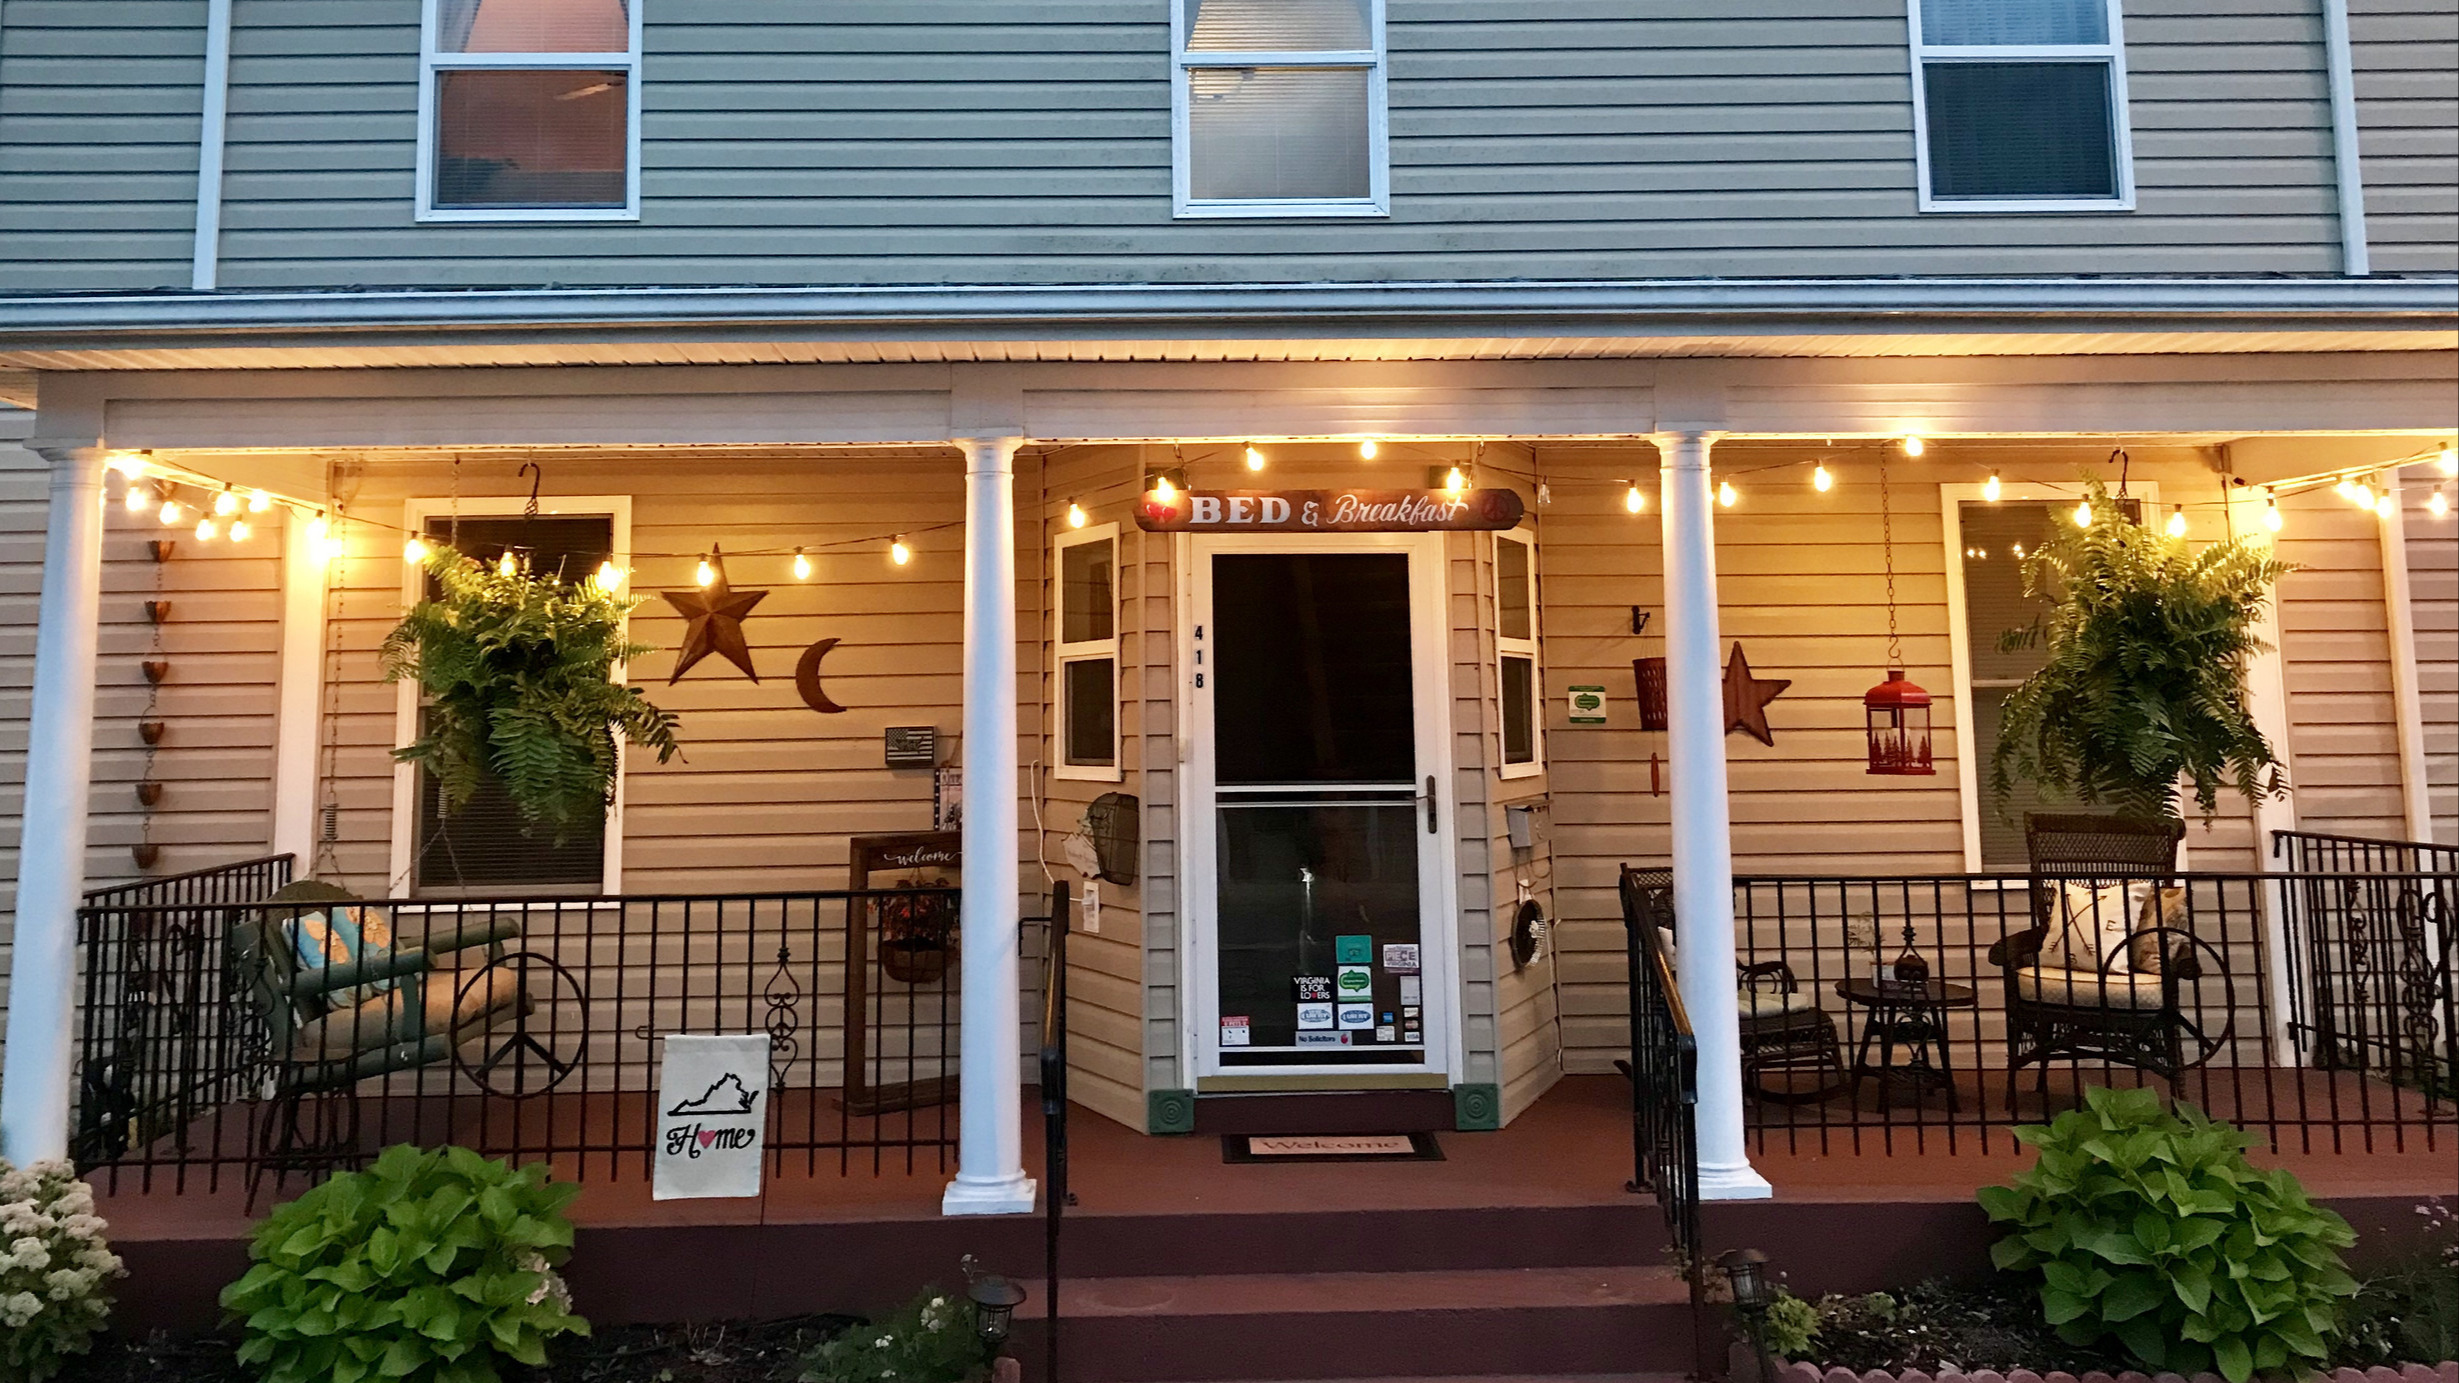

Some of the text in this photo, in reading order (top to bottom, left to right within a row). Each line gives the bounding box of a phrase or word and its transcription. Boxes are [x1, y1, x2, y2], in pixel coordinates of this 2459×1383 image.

[1189, 494, 1469, 526] BED & Breakfast
[1194, 625, 1204, 689] 418
[883, 846, 962, 866] welcome
[2105, 919, 2116, 932] E
[1293, 976, 1331, 984] VIRGINIA
[1300, 984, 1326, 992] IS FOR
[1300, 991, 1331, 999] LOERS
[666, 1122, 755, 1159] Hme
[1263, 1141, 1399, 1150] Welcome
